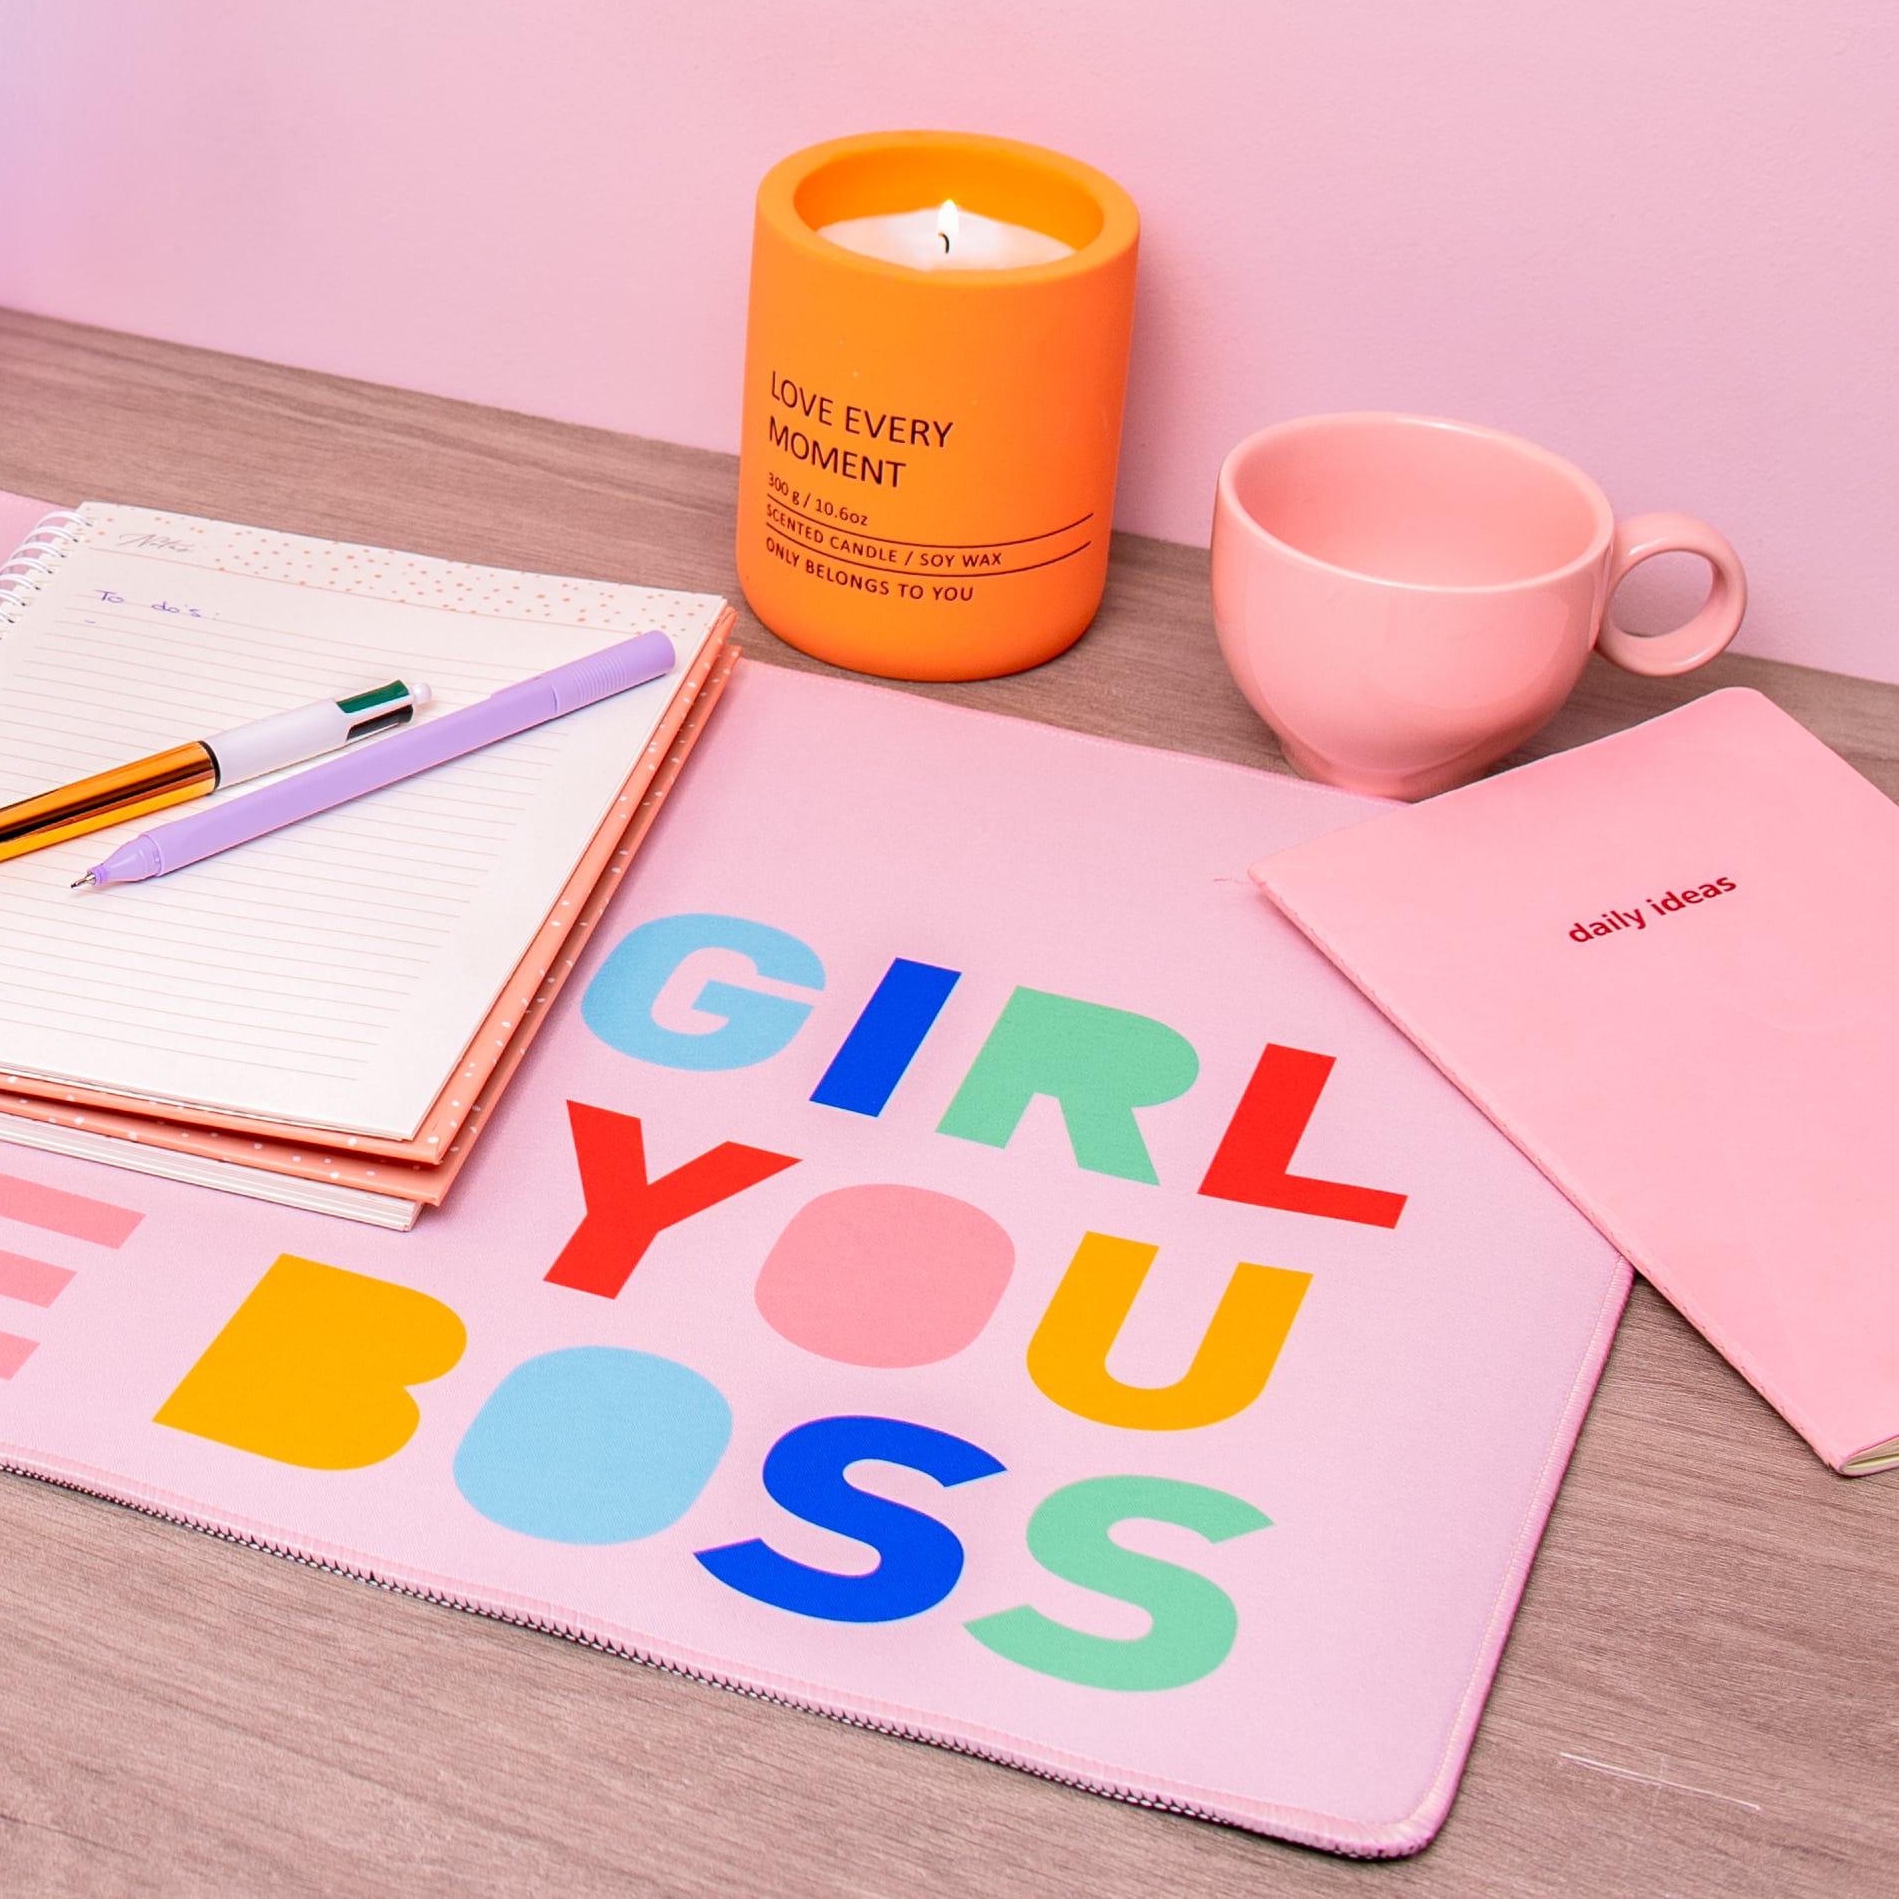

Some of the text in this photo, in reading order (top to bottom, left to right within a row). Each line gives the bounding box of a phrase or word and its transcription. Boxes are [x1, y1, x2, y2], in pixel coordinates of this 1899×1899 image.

[771, 370, 955, 449] LOVE EVERY
[769, 416, 907, 489] MOMENT
[767, 471, 790, 497] 300
[791, 489, 801, 508] g
[815, 498, 870, 527] 10.6oz
[765, 539, 975, 603] ONLY BELONGS TO YOU
[766, 503, 825, 545] SCENTED
[829, 534, 898, 565] CANDLE
[920, 552, 957, 568] SOY
[961, 552, 1003, 568] WAX
[97, 589, 125, 605] To
[1568, 874, 1738, 944] daily ideas
[581, 913, 1408, 1230] GIRL
[542, 1100, 1314, 1432] YOU
[153, 1253, 1275, 1693] BOSS
